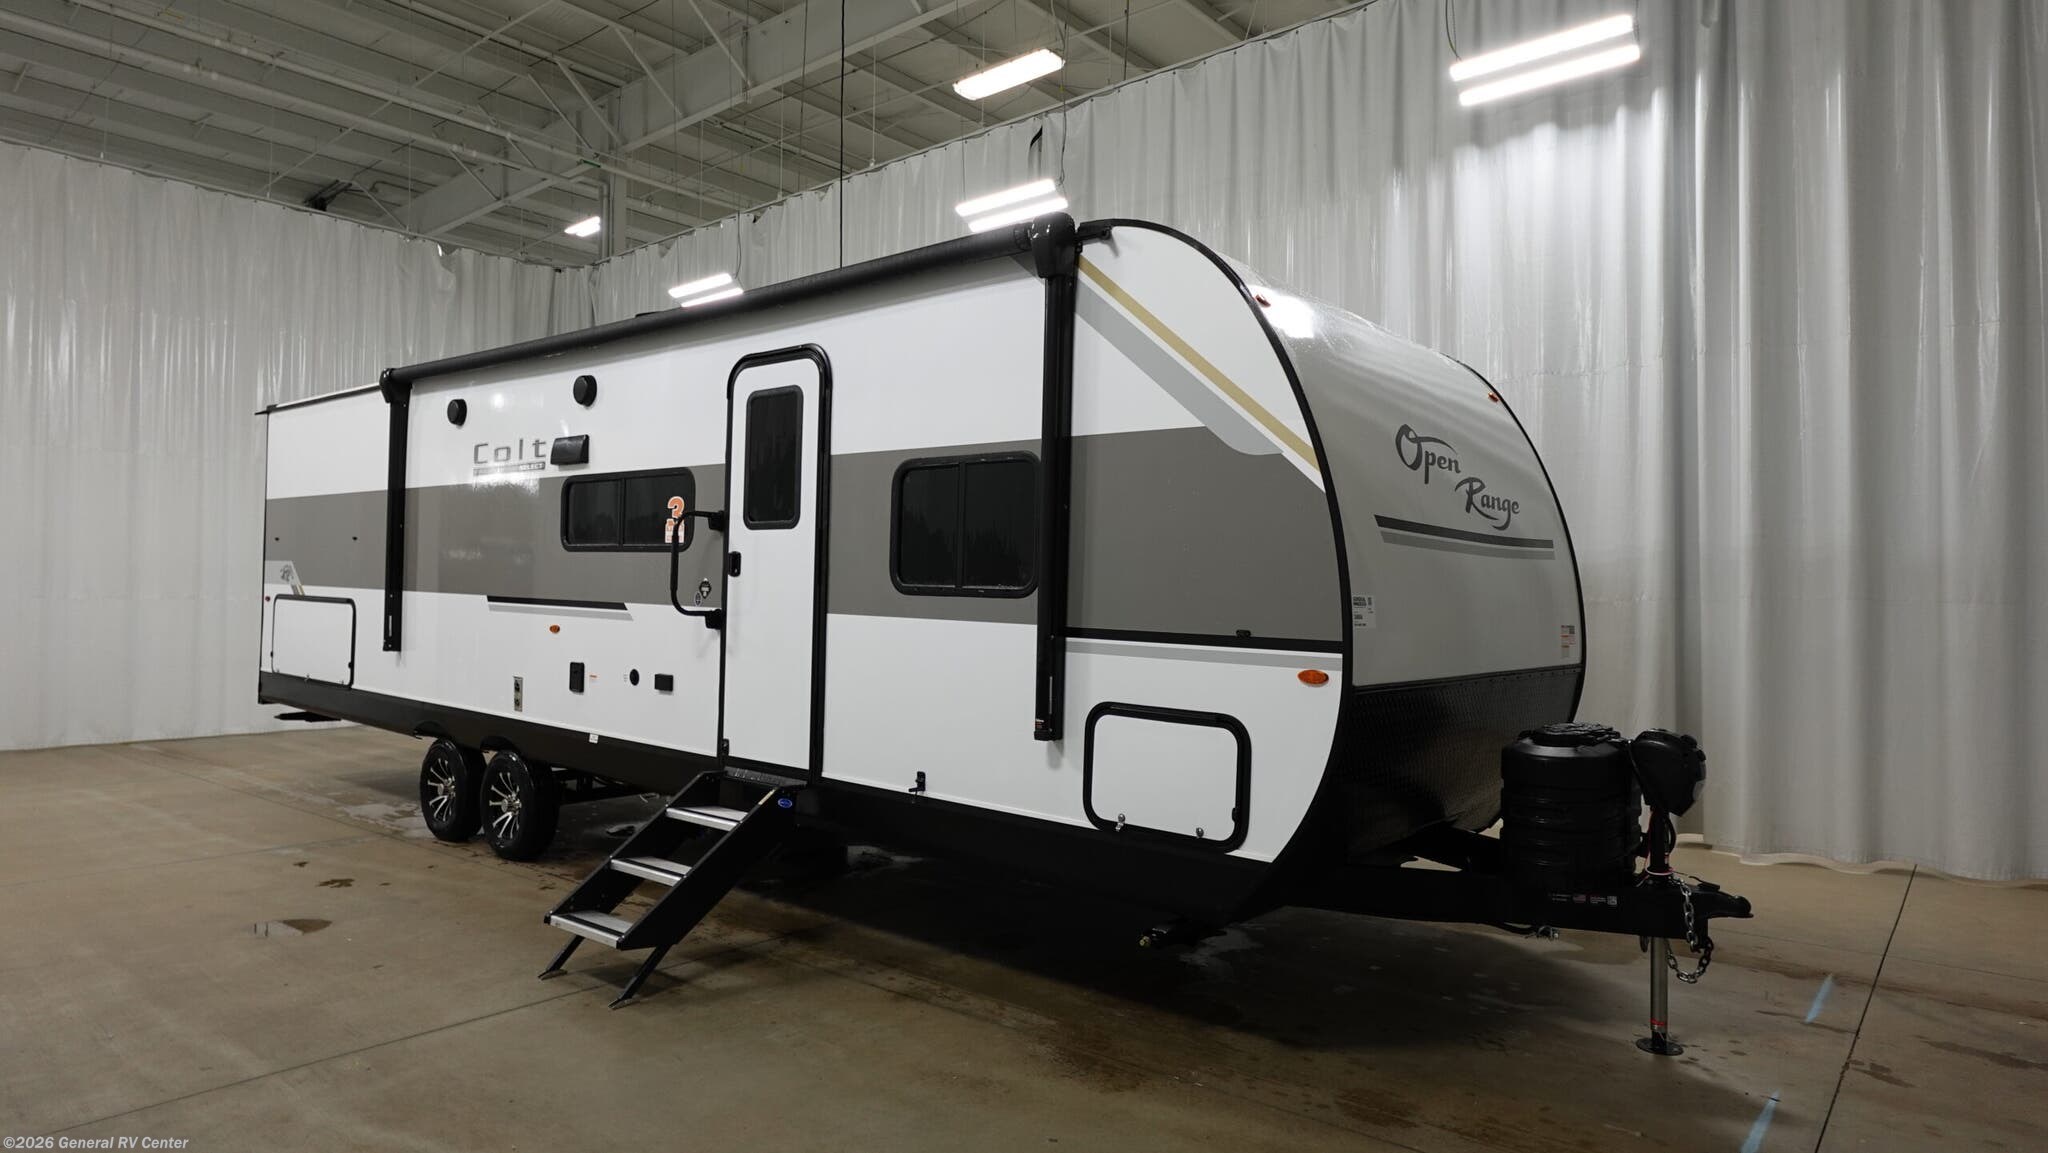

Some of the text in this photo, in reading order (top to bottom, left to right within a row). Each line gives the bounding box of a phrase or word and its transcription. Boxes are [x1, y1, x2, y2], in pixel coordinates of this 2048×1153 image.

[473, 438, 546, 464] Colt
[1395, 423, 1461, 484] Open
[1454, 476, 1520, 530] Range
